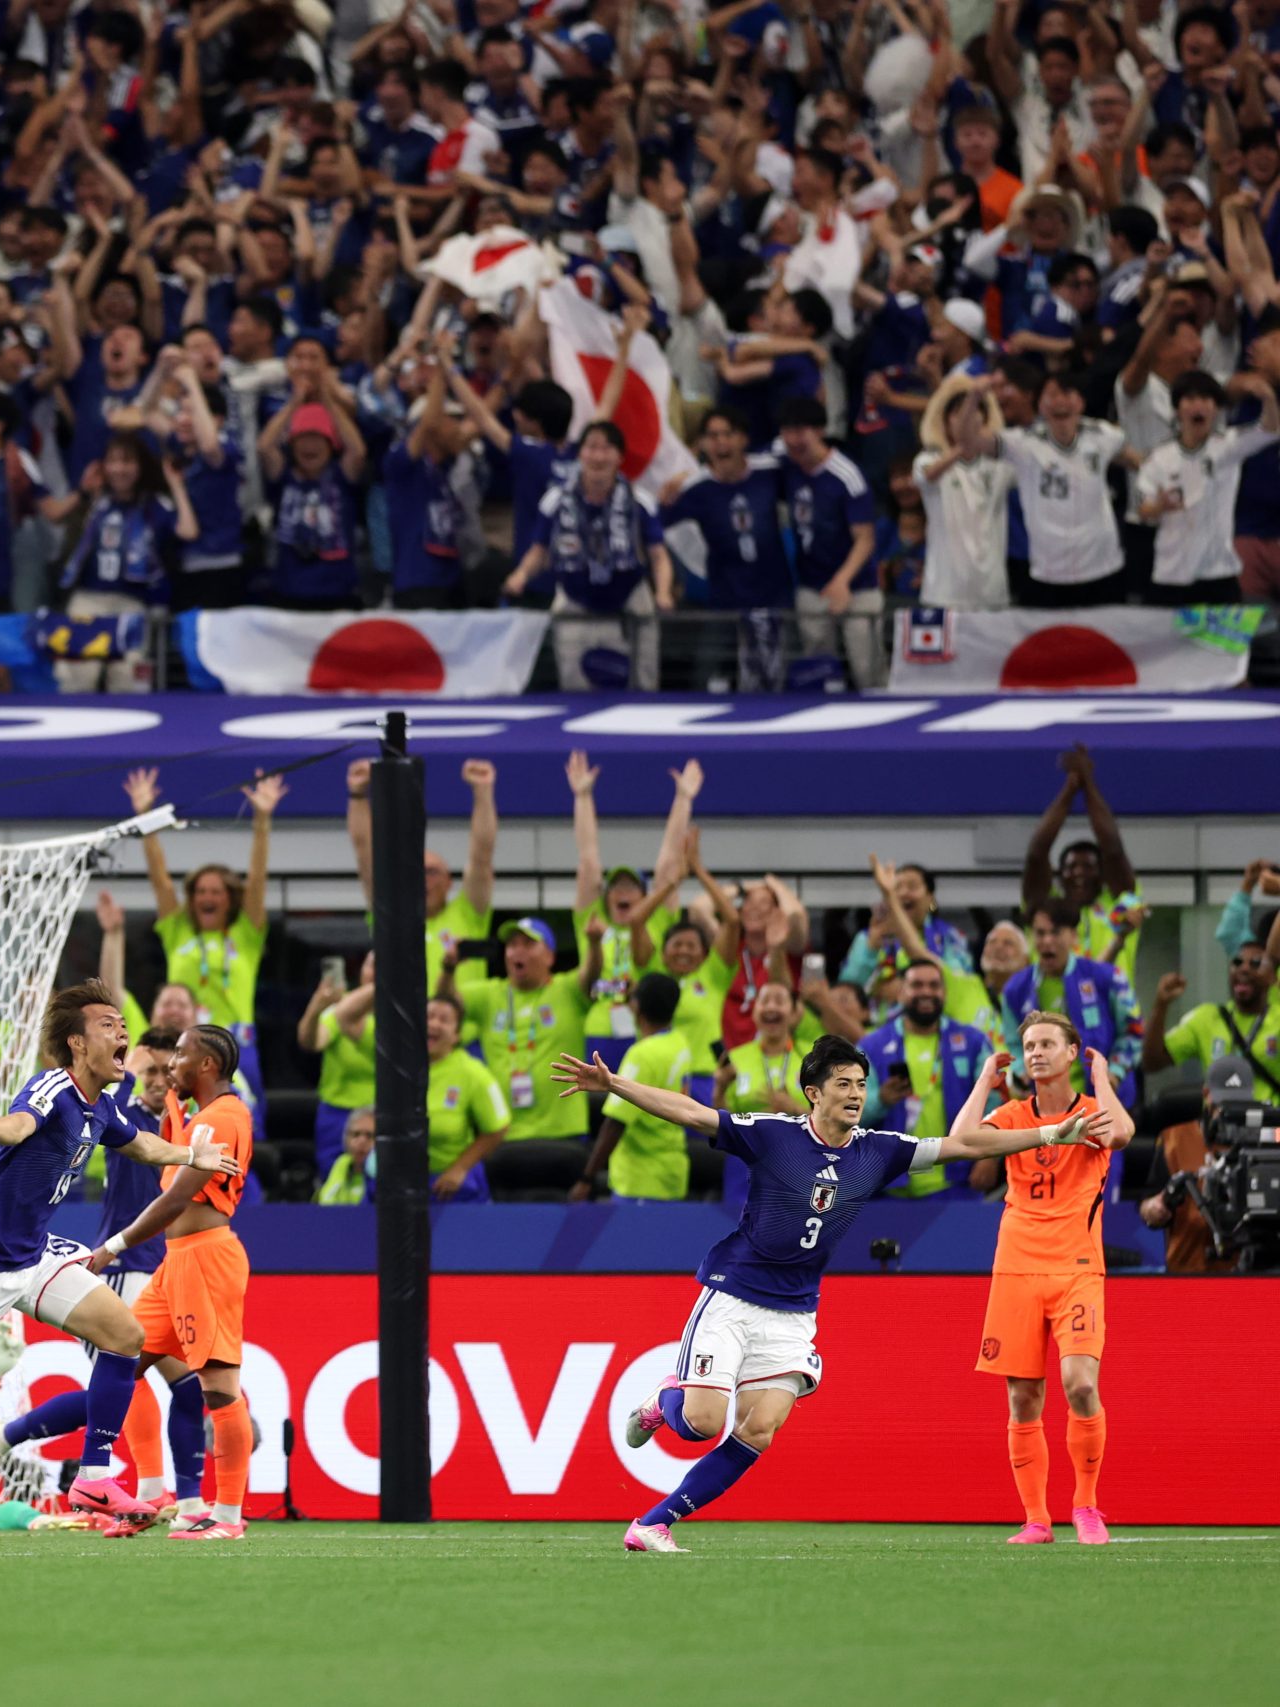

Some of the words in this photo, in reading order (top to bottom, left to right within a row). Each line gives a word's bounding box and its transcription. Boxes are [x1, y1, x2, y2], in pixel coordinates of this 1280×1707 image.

[220, 699, 1280, 739] CUP
[1030, 1171, 1056, 1200] 21
[800, 1217, 823, 1250] 3
[176, 1313, 196, 1345] 26
[1071, 1304, 1096, 1333] 21
